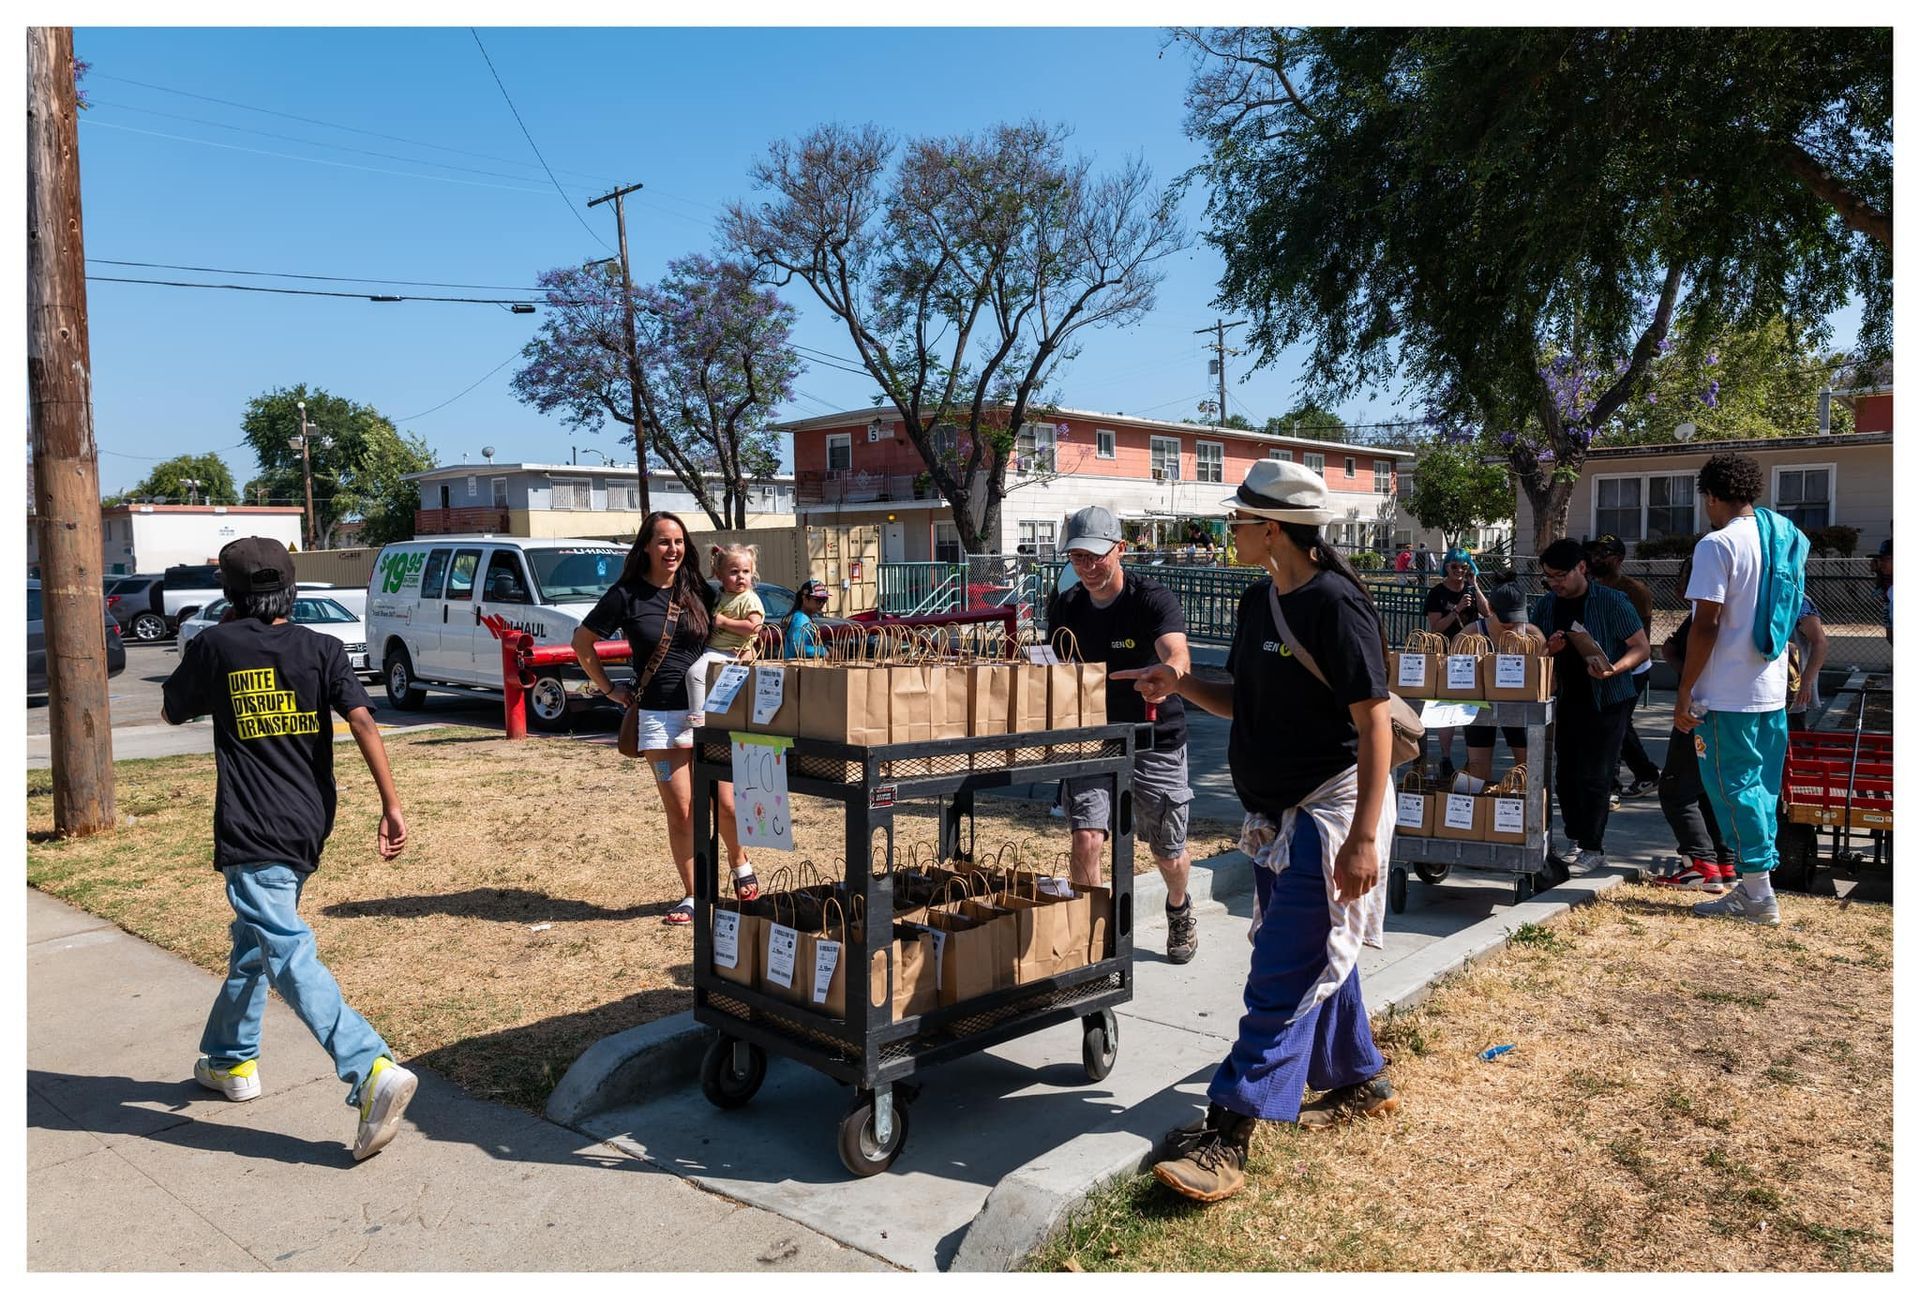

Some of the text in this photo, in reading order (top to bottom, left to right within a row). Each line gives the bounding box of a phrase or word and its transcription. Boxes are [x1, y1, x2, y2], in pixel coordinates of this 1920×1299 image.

[871, 431, 877, 441] 5
[1263, 640, 1280, 652] GEN
[230, 670, 273, 692] UNITE
[233, 692, 294, 716] DISRUPT
[238, 713, 319, 738] TRANSFORM
